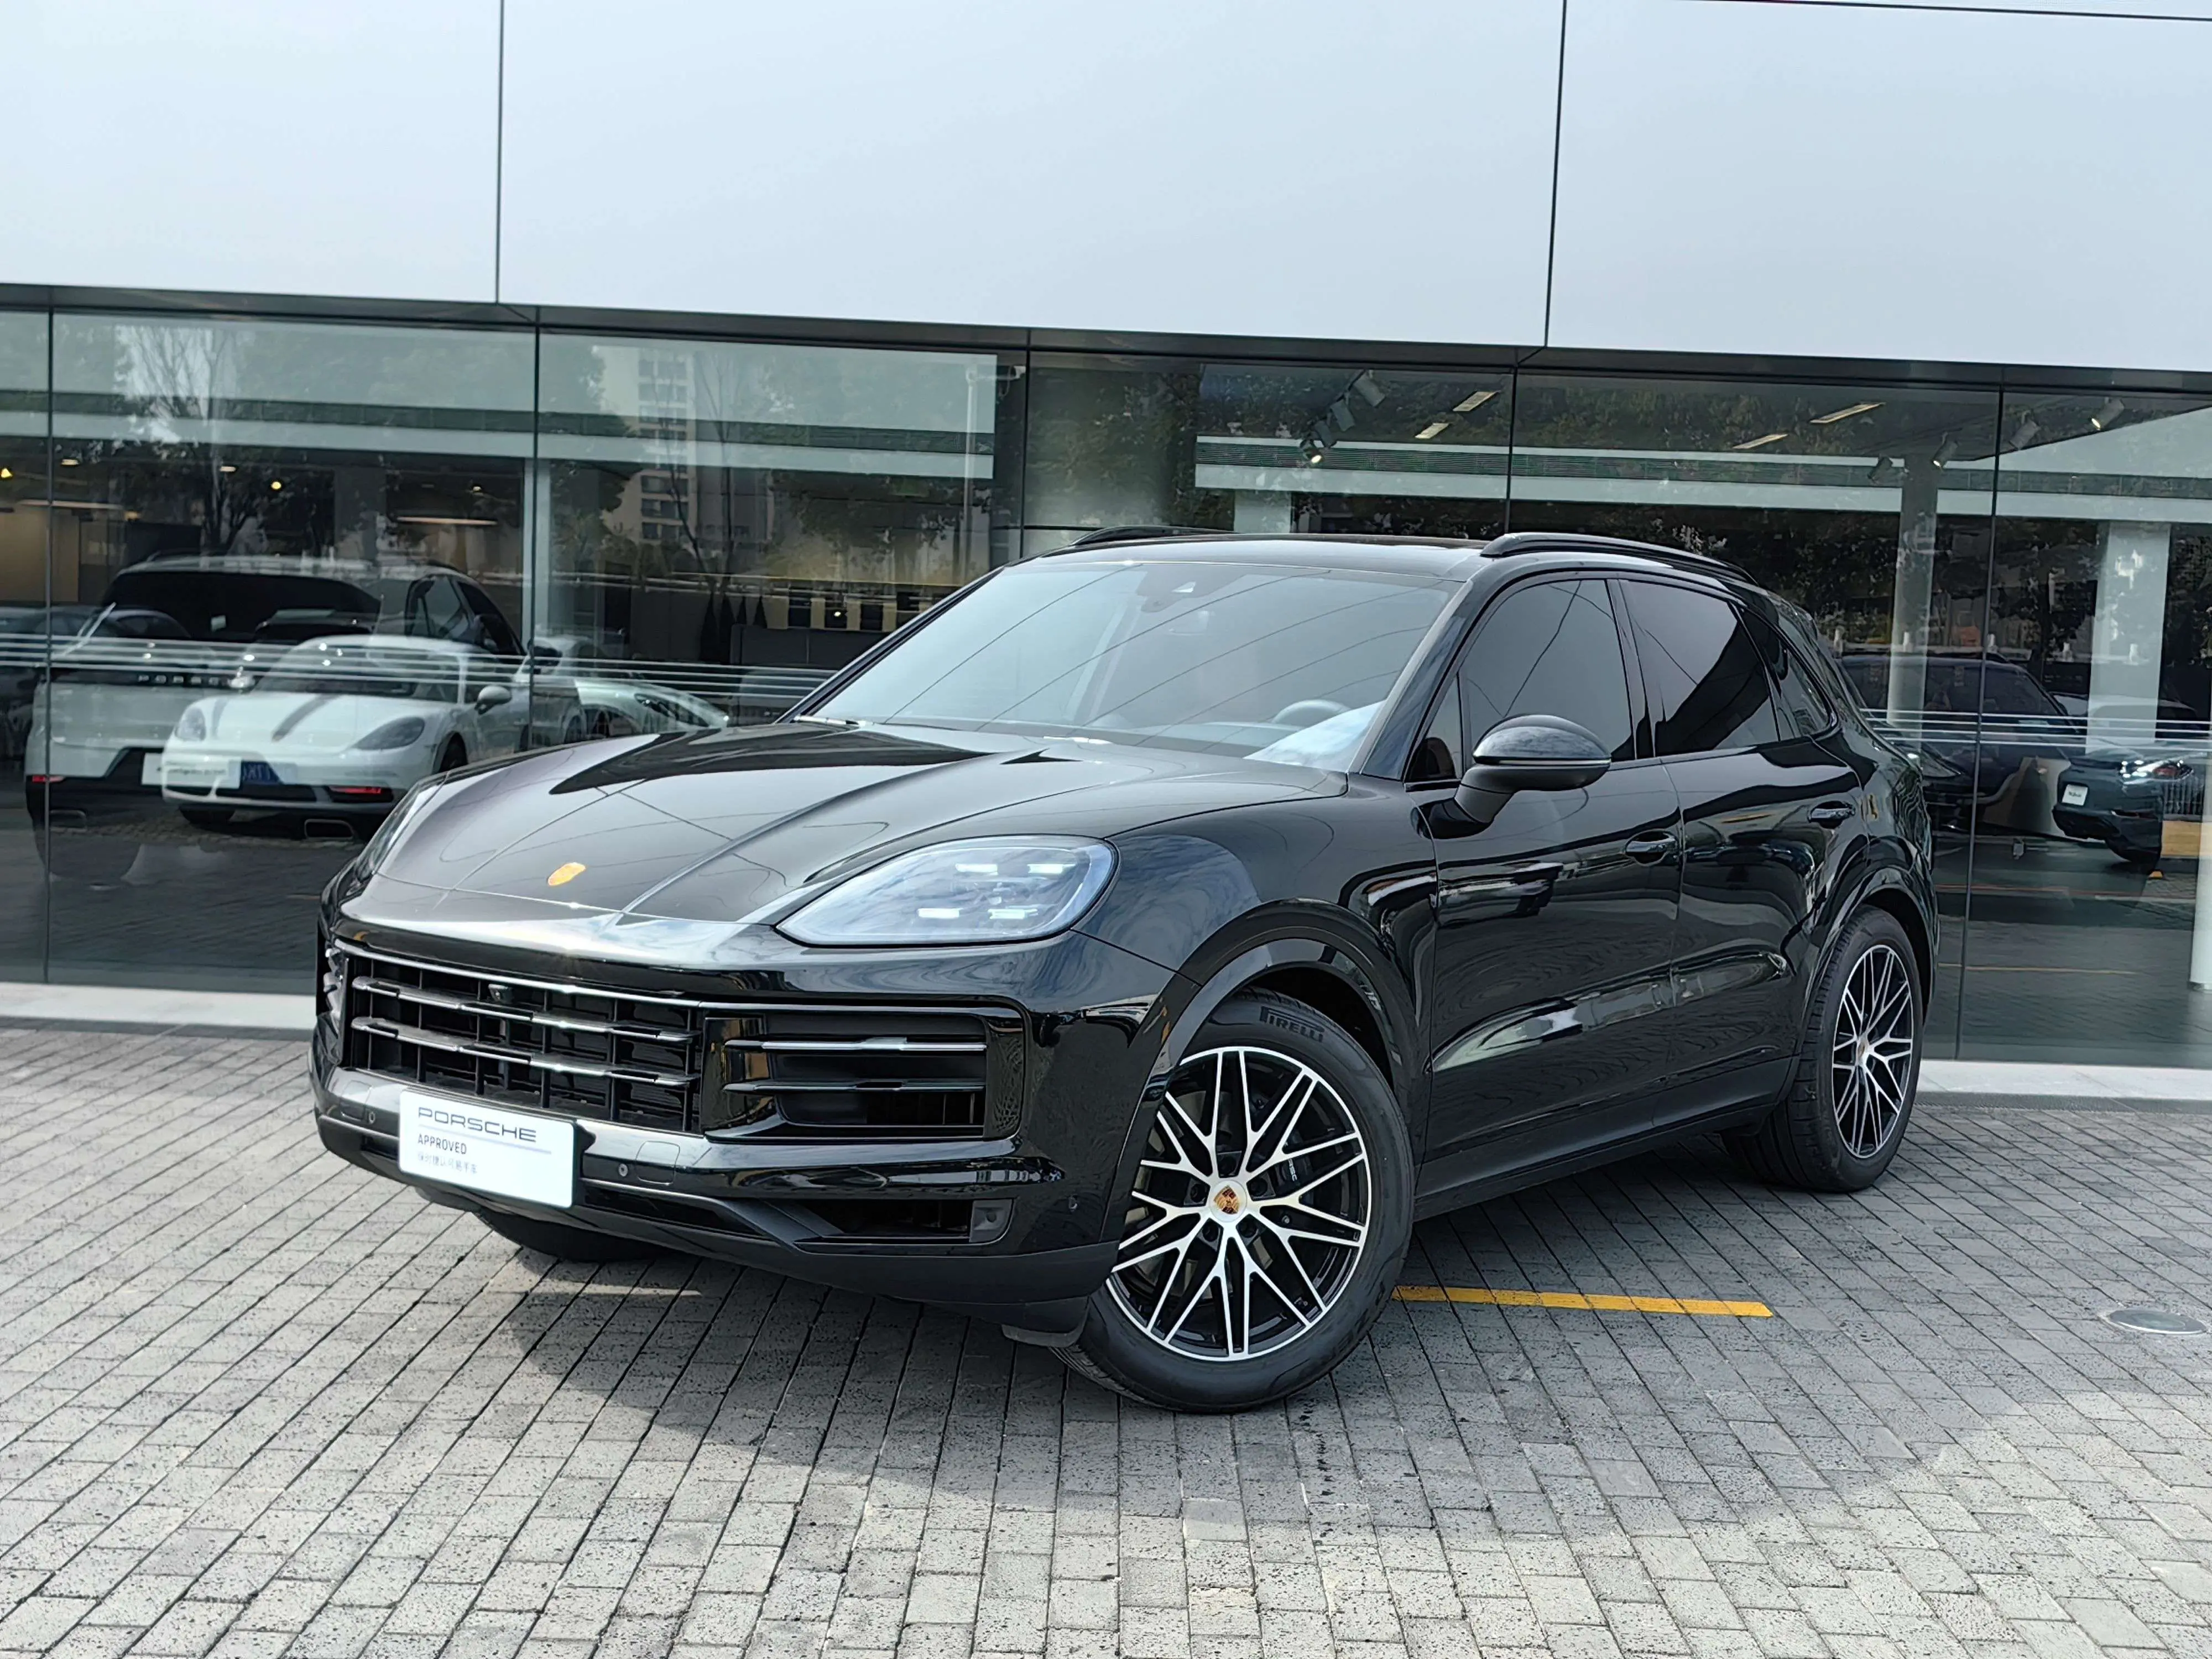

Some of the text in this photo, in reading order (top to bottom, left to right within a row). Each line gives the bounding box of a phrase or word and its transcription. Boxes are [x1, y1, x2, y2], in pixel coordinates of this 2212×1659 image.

[1259, 1005, 1324, 1043] PIRELLI
[418, 1107, 536, 1142] PORSCHE
[418, 1133, 467, 1155] APPROVED
